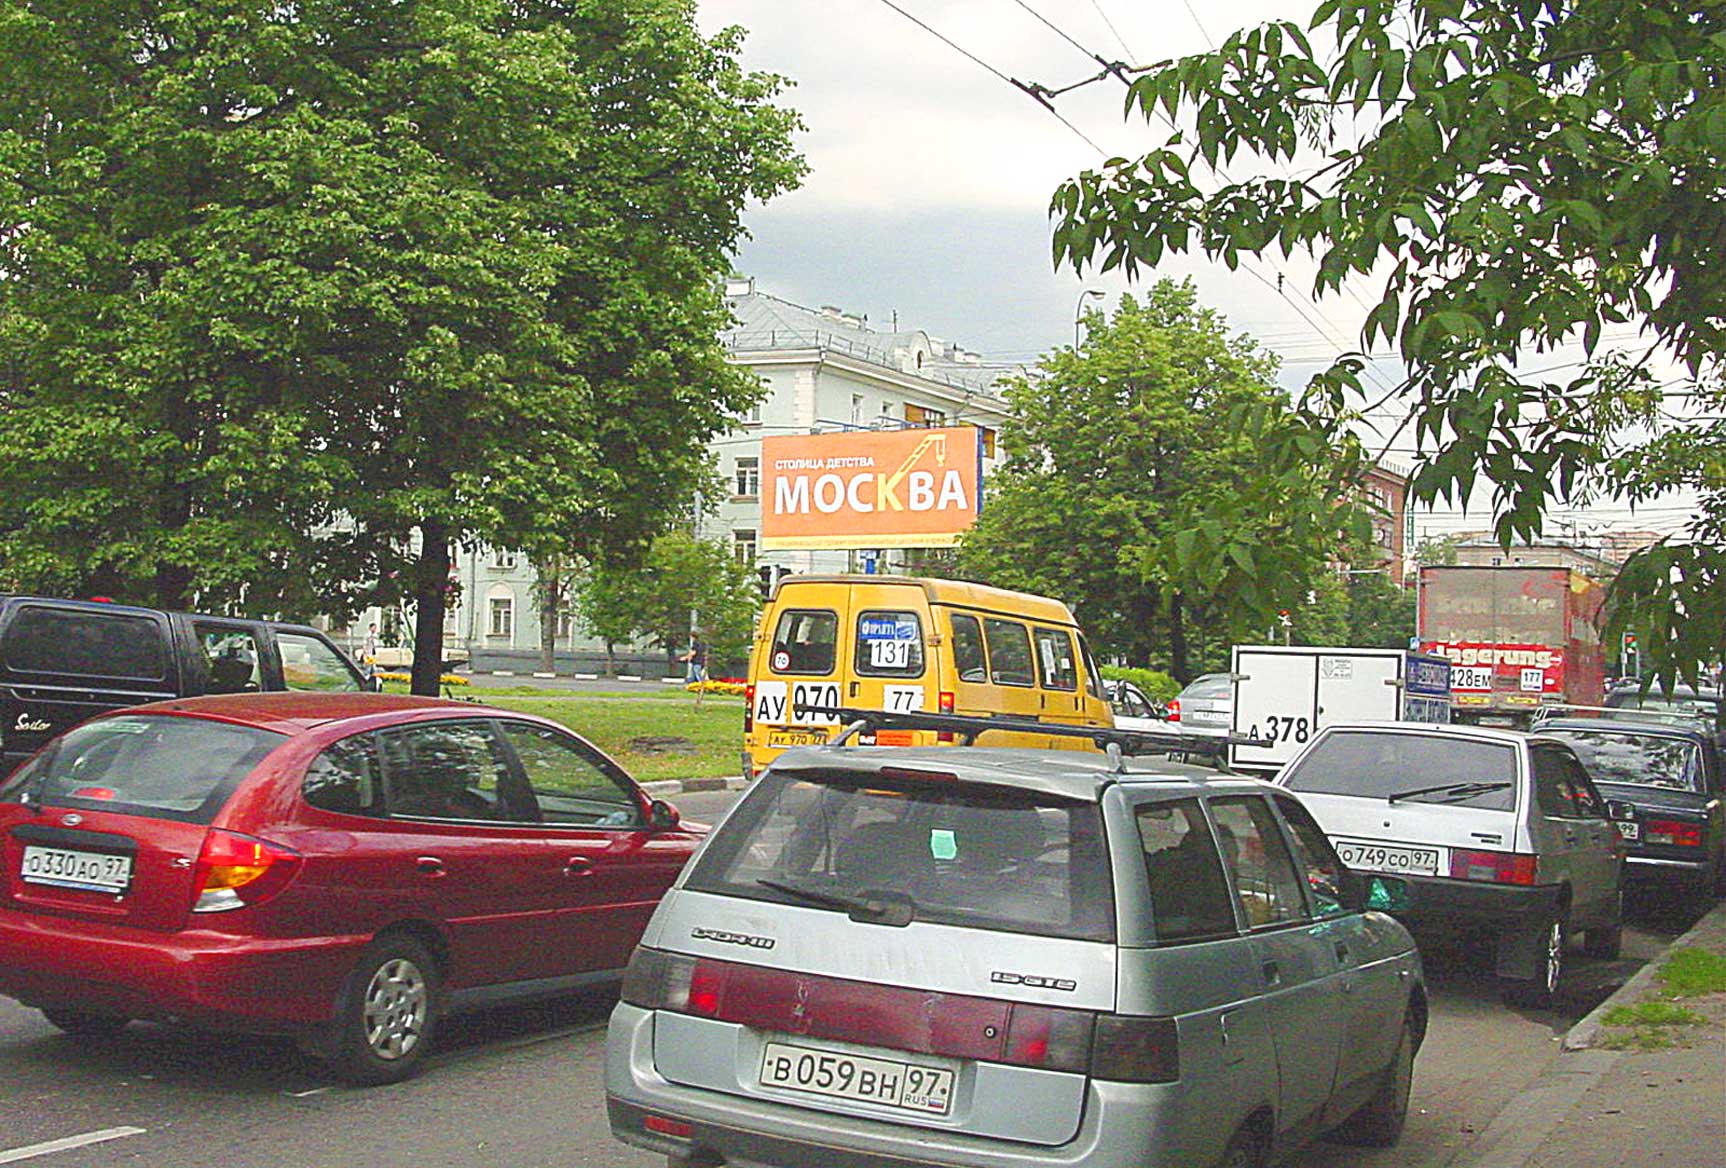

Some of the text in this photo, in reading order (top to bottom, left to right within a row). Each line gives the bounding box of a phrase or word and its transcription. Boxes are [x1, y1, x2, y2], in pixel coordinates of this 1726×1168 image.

[775, 456, 875, 470] СТОЛИЦА ДЕТСТВА
[774, 470, 968, 514] МОСКВА
[875, 641, 906, 665] 131
[893, 691, 915, 710] 77
[1413, 853, 1431, 864] 97
[909, 1070, 941, 1097] 97
[904, 1093, 928, 1107] RUS
